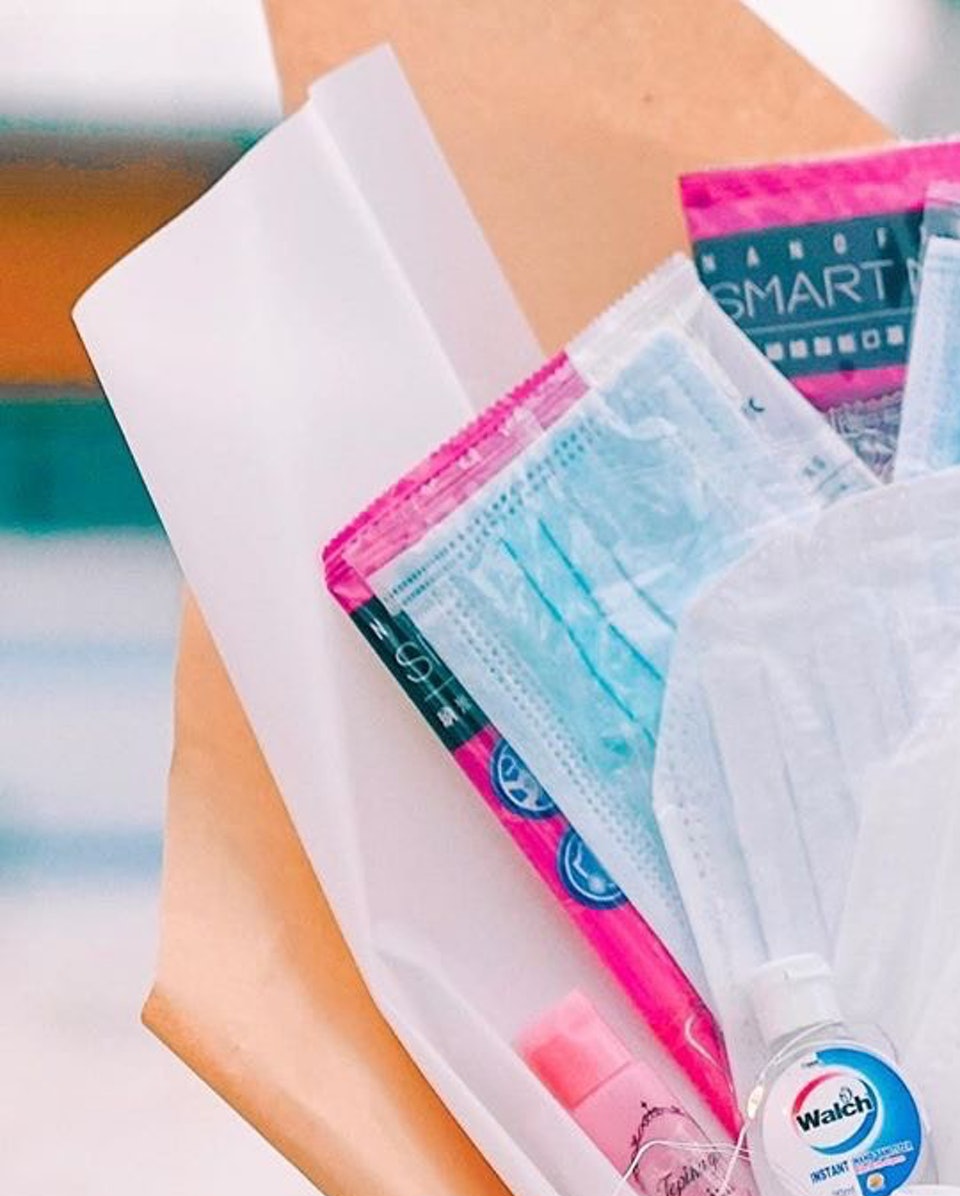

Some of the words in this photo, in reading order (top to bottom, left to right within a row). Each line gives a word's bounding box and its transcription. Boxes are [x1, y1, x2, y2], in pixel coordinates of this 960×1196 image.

[708, 258, 894, 321] SMART
[796, 1095, 873, 1132] Walch
[810, 1160, 849, 1183] INSTANT
